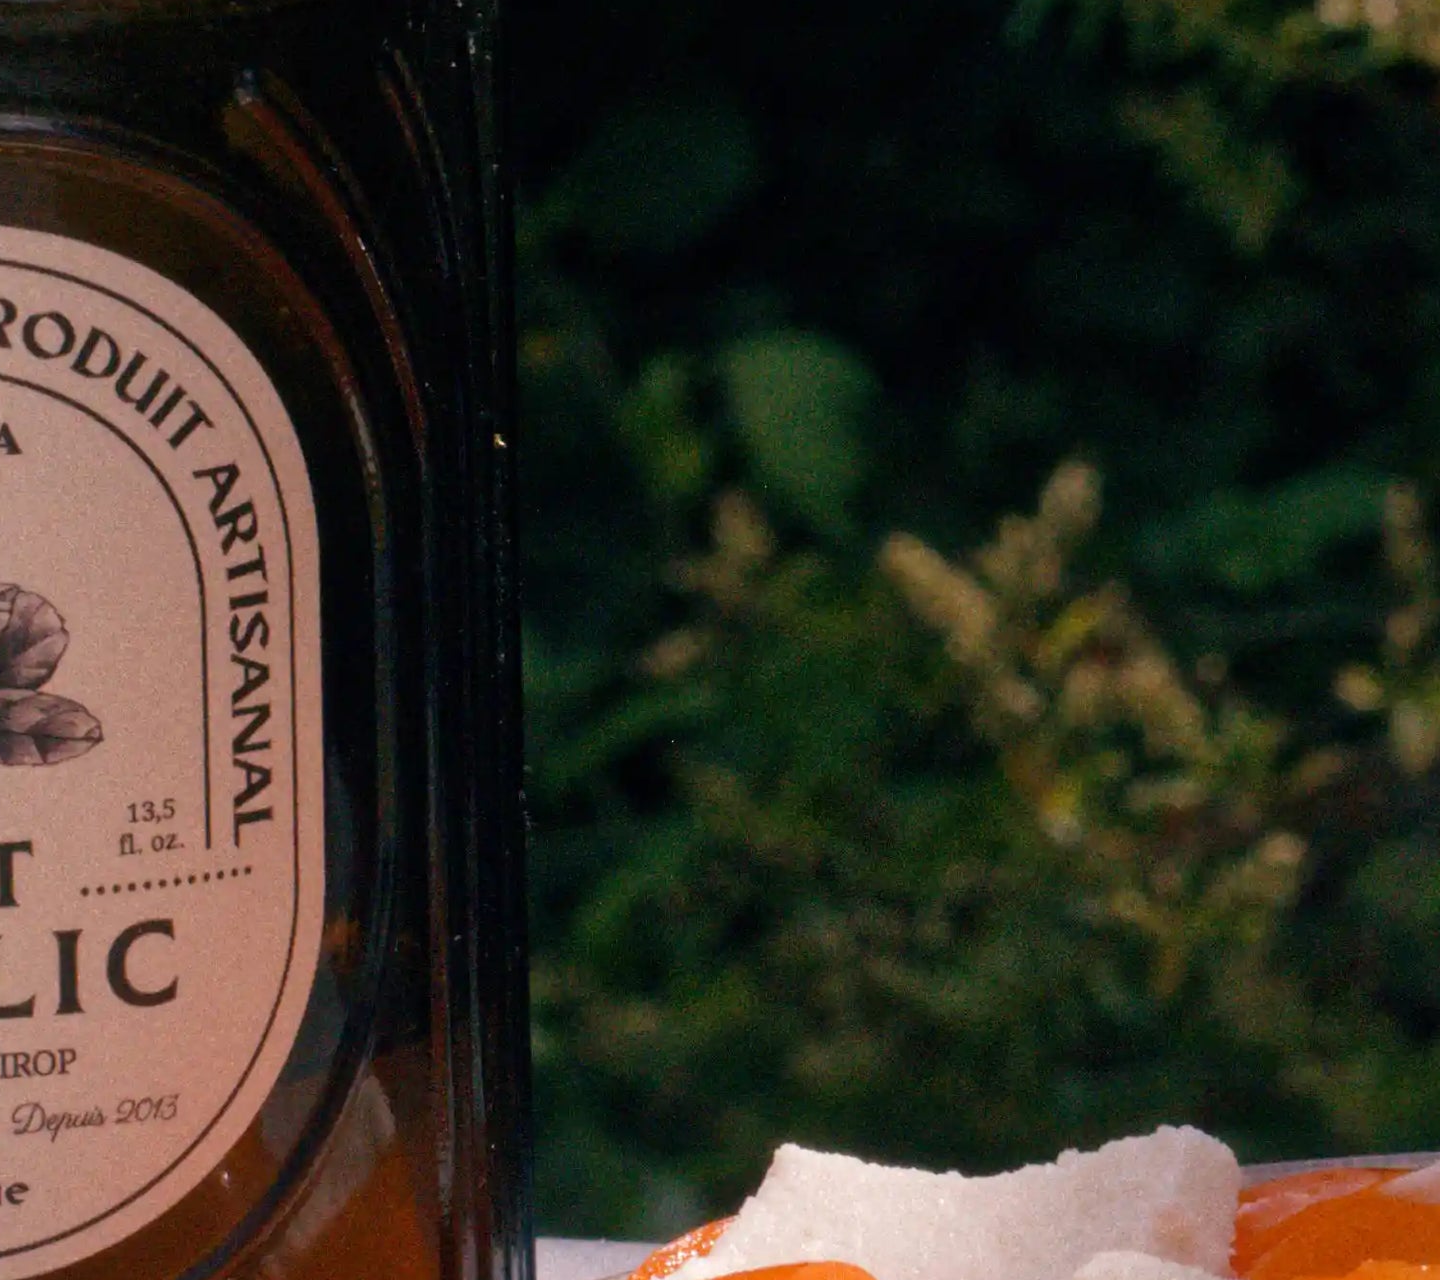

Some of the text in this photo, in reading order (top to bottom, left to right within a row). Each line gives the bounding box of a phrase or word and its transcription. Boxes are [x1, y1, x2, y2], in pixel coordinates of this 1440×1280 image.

[194, 460, 277, 848] ARTISANAL
[126, 798, 177, 826] 13,5
[118, 833, 185, 856] fl. oz.
[11, 1101, 105, 1143] Depuis
